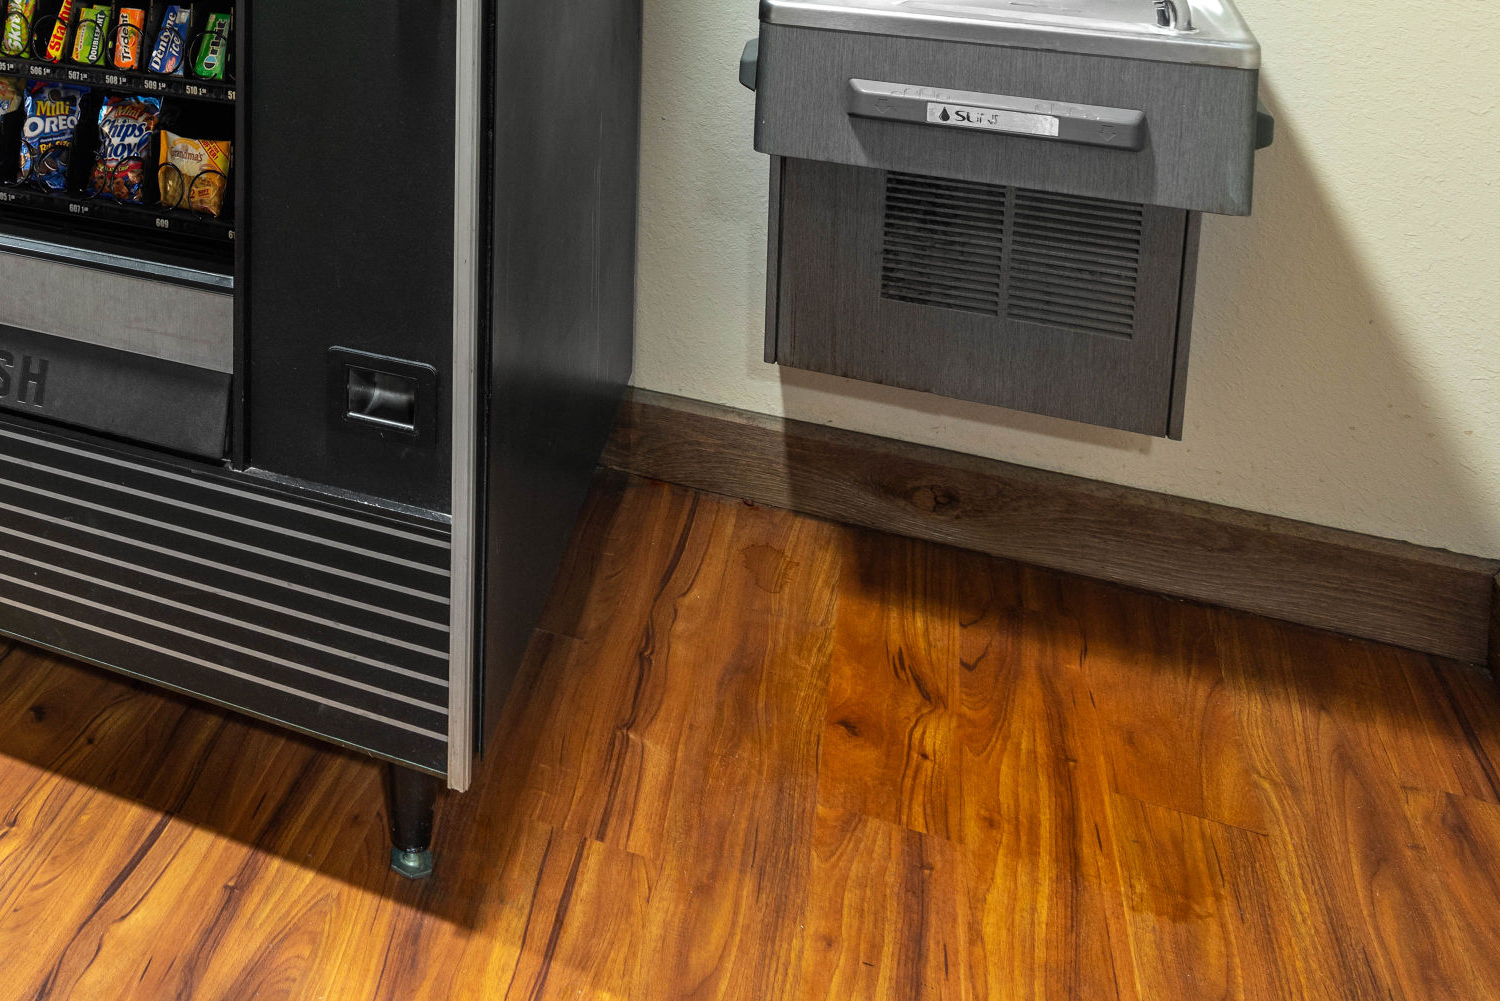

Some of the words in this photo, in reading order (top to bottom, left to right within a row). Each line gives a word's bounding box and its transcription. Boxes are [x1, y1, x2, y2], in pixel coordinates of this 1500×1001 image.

[120, 13, 132, 63] Trident
[151, 12, 177, 71] Dentyne
[30, 66, 43, 75] 506
[68, 71, 80, 80] 507
[105, 75, 118, 84] 508
[144, 80, 157, 89] 509
[186, 85, 198, 95] 510
[36, 100, 70, 117] Mini
[114, 104, 141, 120] Mini
[23, 115, 79, 138] OREO
[100, 118, 148, 139] Chips
[171, 148, 205, 162] Grandma's
[69, 204, 80, 213] 607
[155, 218, 169, 228] 609
